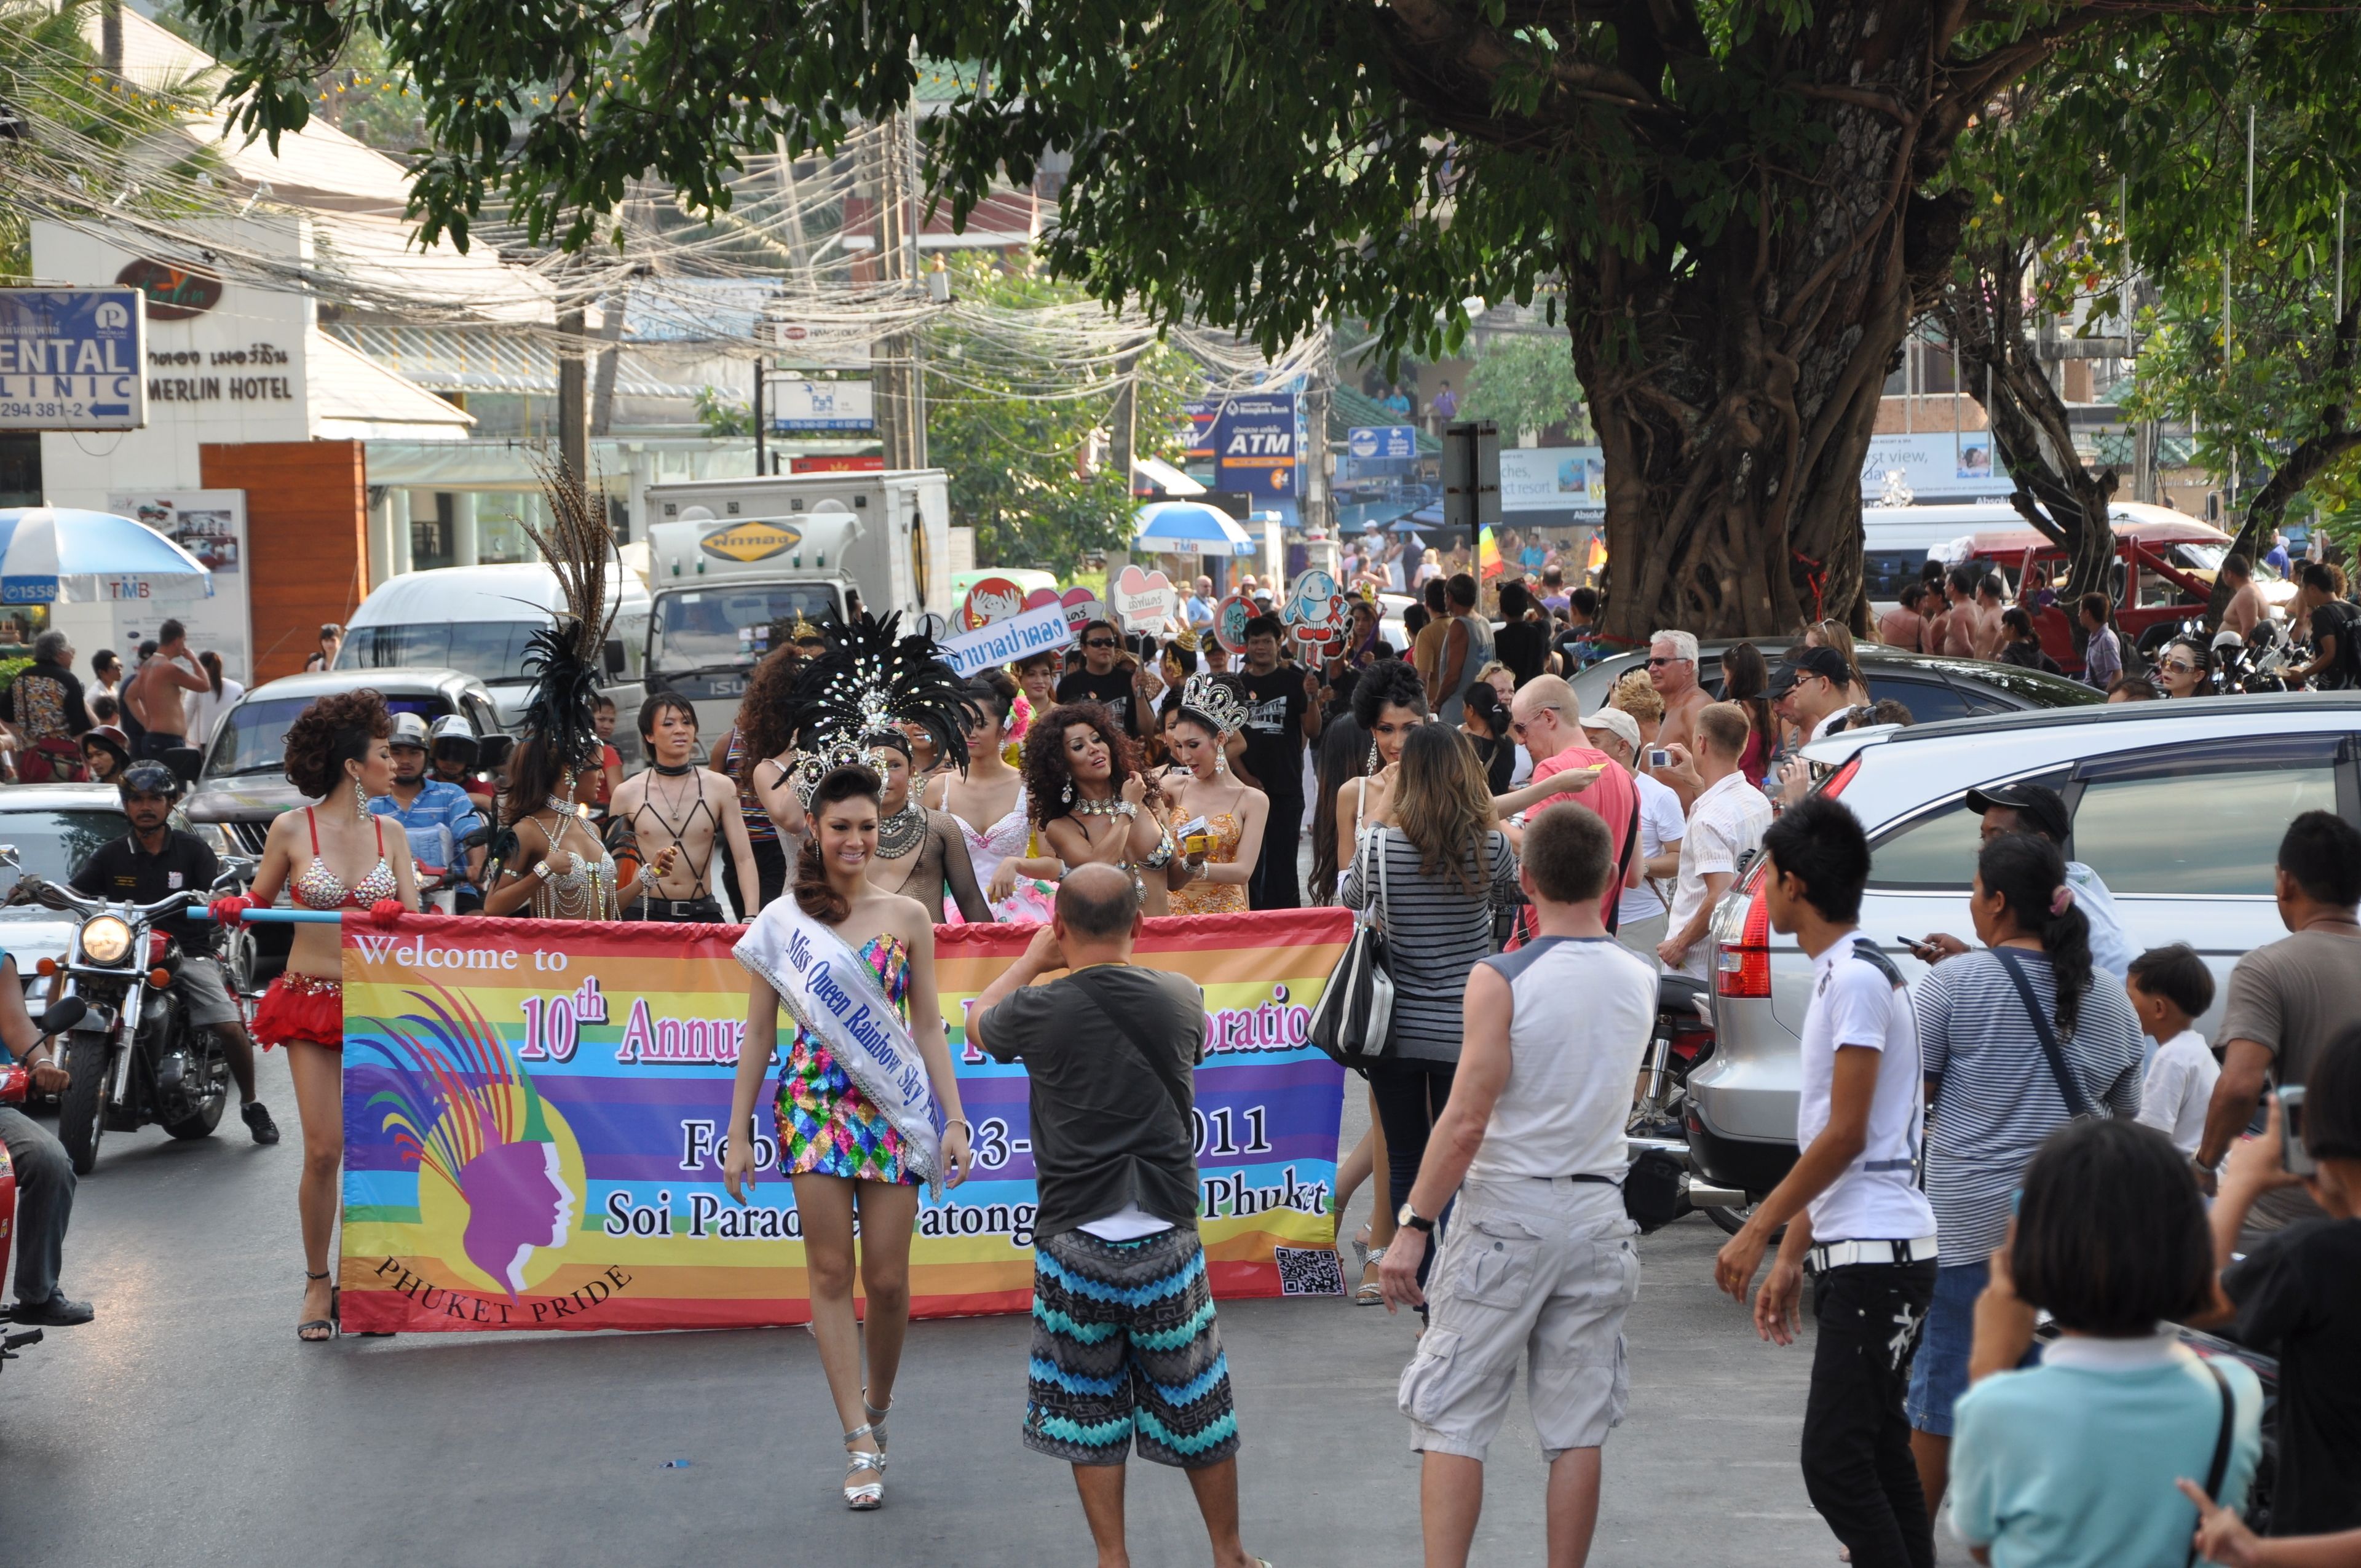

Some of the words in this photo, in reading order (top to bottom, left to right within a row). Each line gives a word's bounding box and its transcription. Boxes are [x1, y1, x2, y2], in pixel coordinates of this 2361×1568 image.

[0, 339, 130, 373] ENTAL
[0, 376, 130, 398] LINIC
[229, 377, 292, 400] HOTEL
[36, 403, 83, 418] 381-2
[1227, 434, 1290, 454] ATM
[1889, 449, 1928, 464] view,
[1501, 464, 1531, 479] ches,
[1518, 480, 1551, 494] resort
[1173, 541, 1198, 552] TMB
[19, 584, 55, 598] 1558
[109, 580, 150, 598] TMB
[710, 681, 747, 695] ISU
[352, 934, 518, 970] Welcome
[534, 948, 568, 972] to
[518, 975, 607, 1060] 10th
[785, 927, 813, 974] Miss
[805, 960, 852, 1018] Queen
[842, 1002, 903, 1076] Rainbow
[896, 1063, 925, 1106] Sky
[606, 1190, 673, 1237] Soi
[1201, 1165, 1329, 1221] Phuket
[374, 1255, 513, 1323] PHUKET
[529, 1264, 633, 1323] PRIDE
